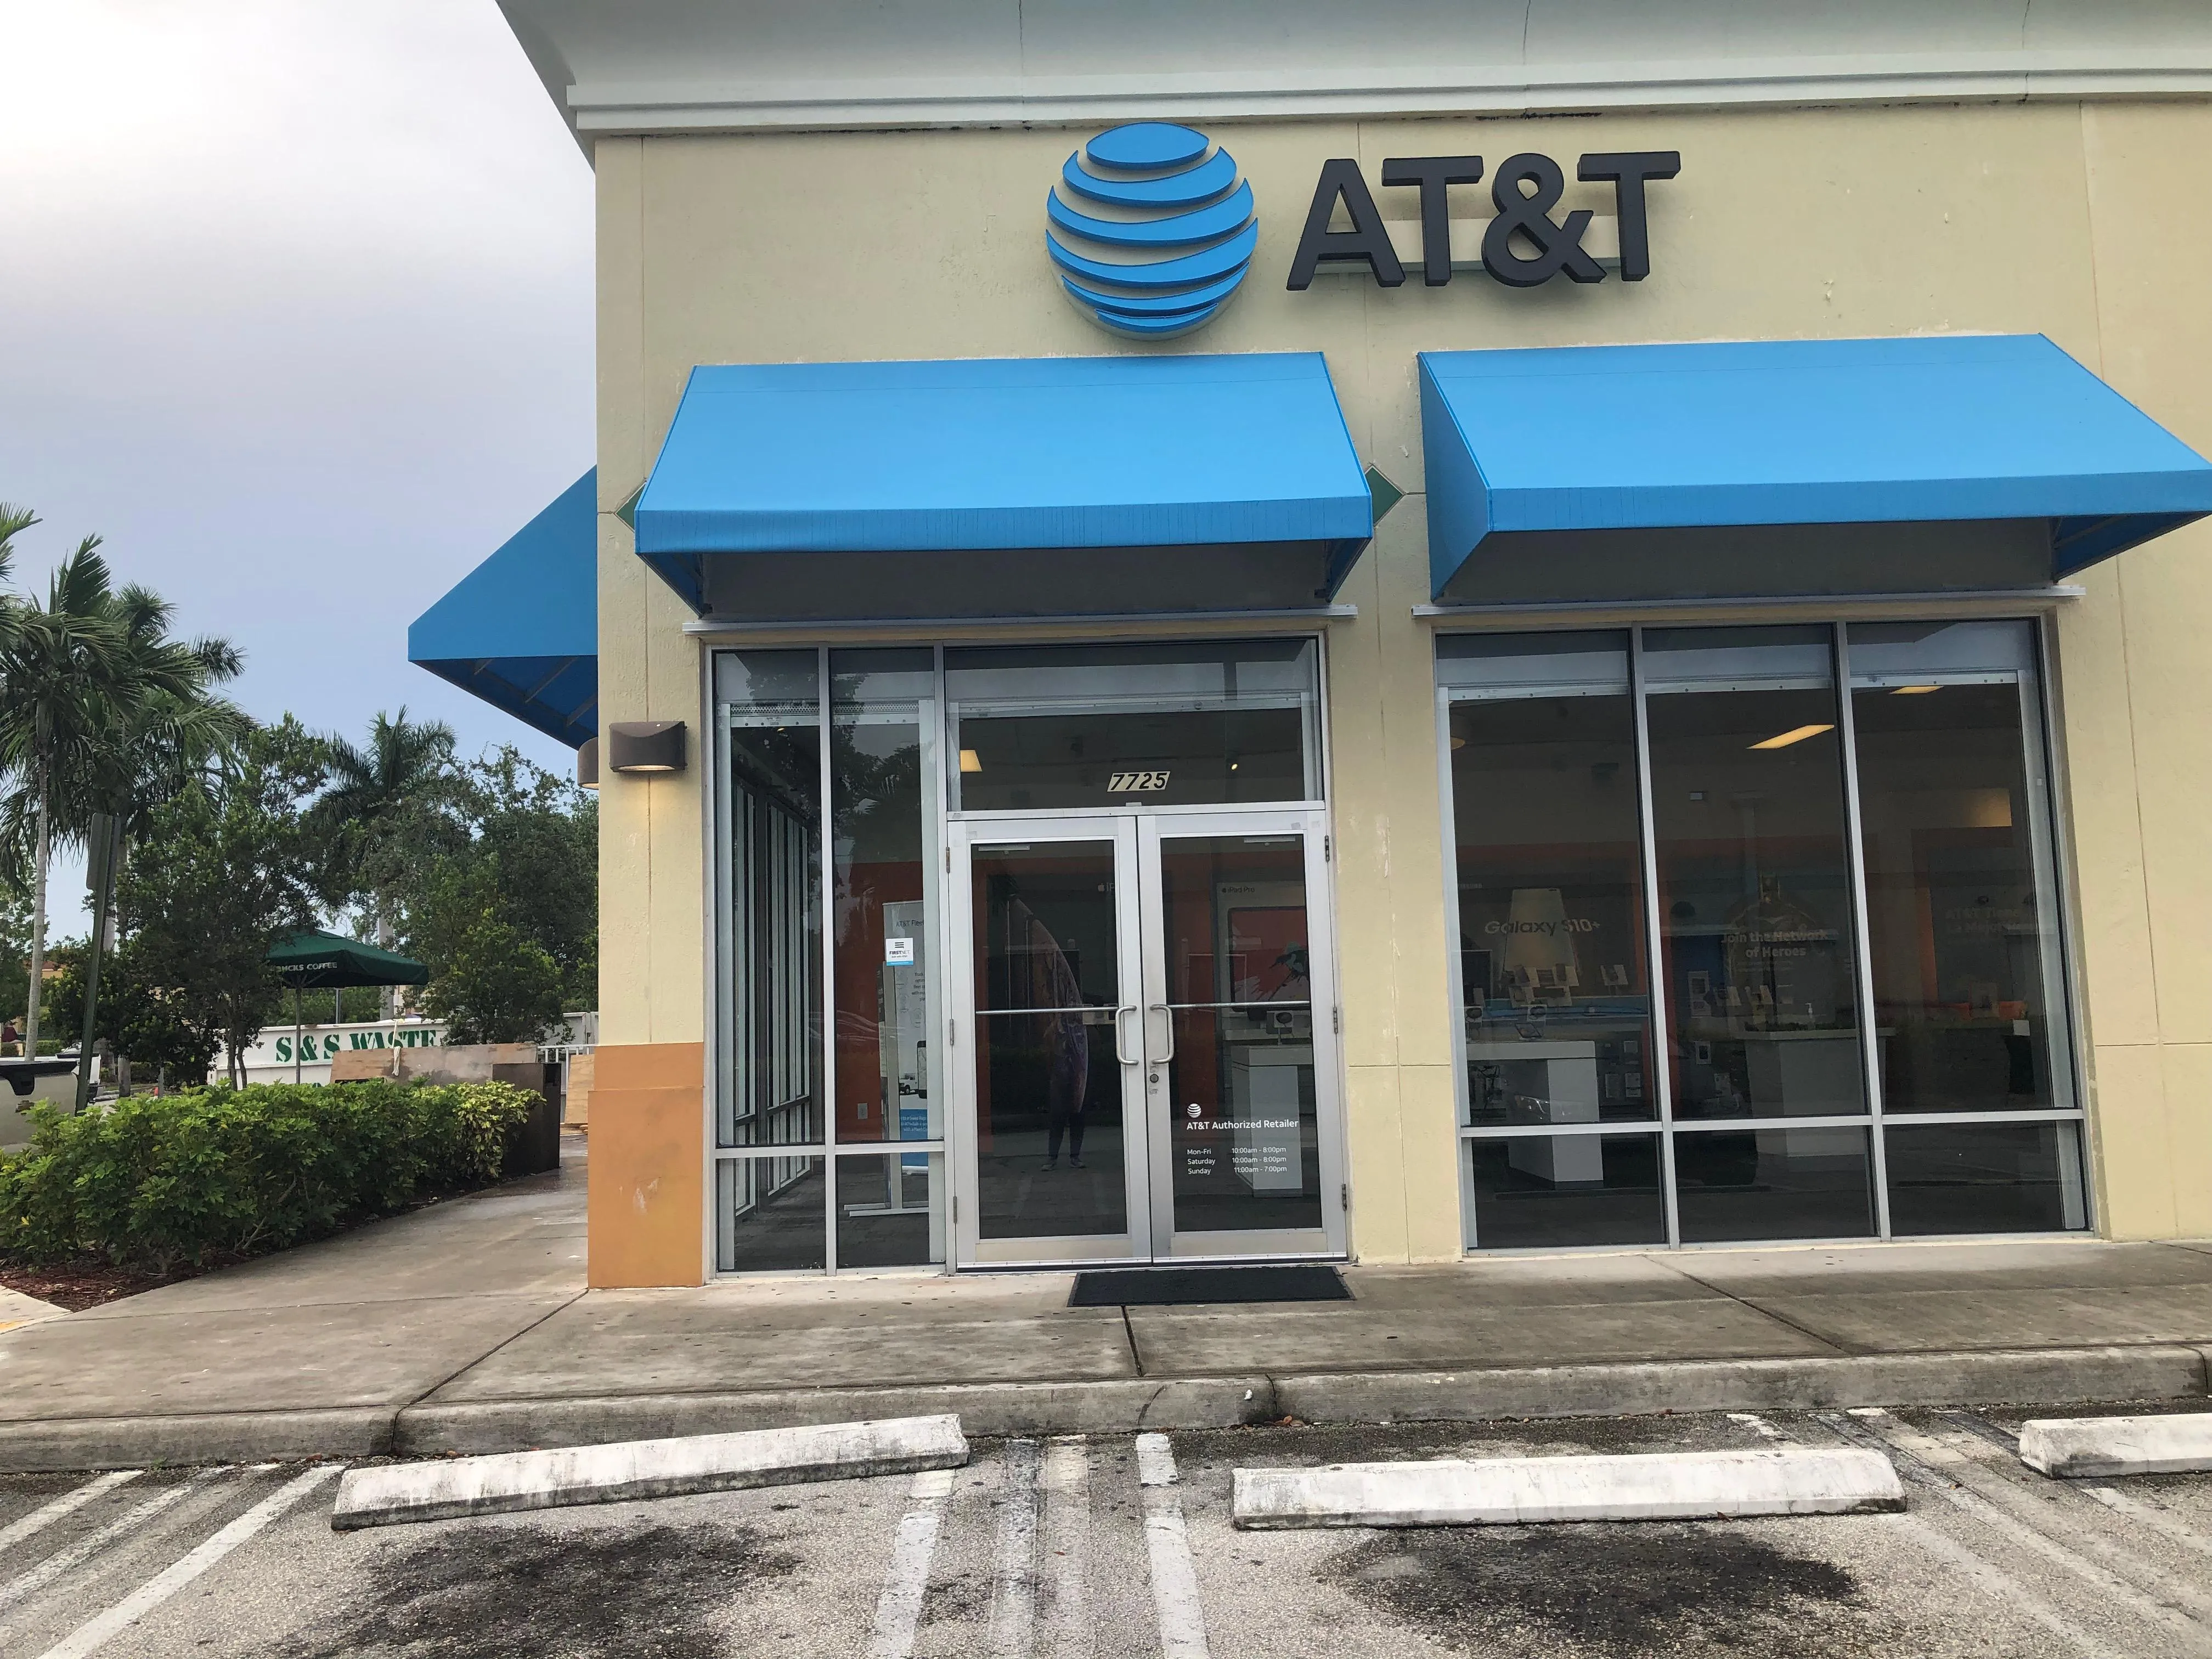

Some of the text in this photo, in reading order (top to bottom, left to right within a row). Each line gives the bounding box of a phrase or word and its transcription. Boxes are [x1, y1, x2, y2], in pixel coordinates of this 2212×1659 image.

[1286, 150, 1681, 291] AT&T
[1110, 772, 1167, 791] 7725
[1485, 918, 1601, 936] Galaxy S10+
[1721, 934, 1748, 944] Join
[1750, 931, 1771, 943] the
[1745, 946, 1806, 958] of Heroes
[307, 962, 337, 970] COFFEE
[1187, 1119, 1299, 1130] AT&T Authorized Retailer
